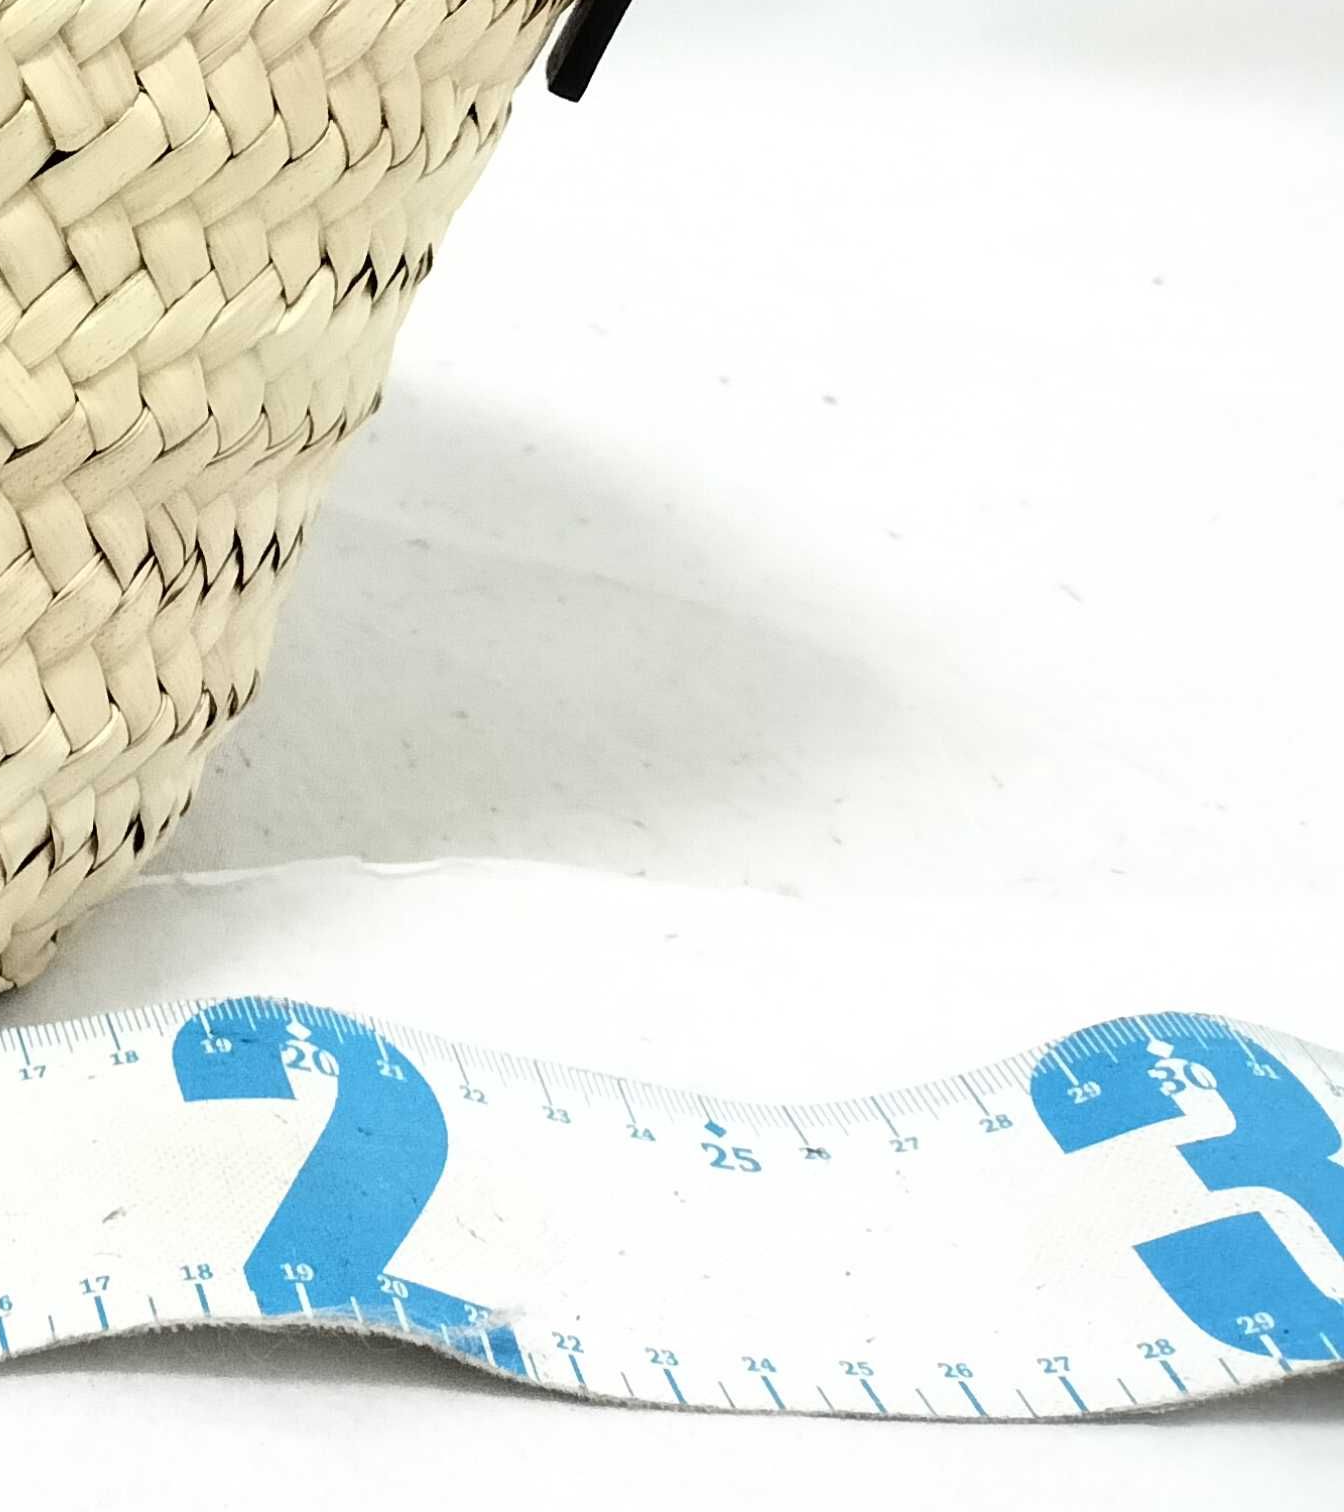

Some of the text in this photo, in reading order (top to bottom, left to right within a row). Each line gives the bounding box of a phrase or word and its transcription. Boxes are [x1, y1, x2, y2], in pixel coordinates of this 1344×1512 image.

[18, 1065, 47, 1081] 17
[110, 1050, 139, 1066] 18
[200, 1038, 234, 1055] 19
[278, 1039, 340, 1077] 20
[460, 1085, 488, 1105] 22
[543, 1105, 572, 1124] 23
[627, 1124, 656, 1143] 24
[701, 1143, 762, 1173] 25
[889, 1137, 920, 1154] 27
[979, 1114, 1013, 1134] 28
[1067, 1081, 1102, 1105] 29
[1146, 1057, 1217, 1096] 30
[172, 996, 528, 1378] 2
[1030, 1011, 1344, 1362] 3
[79, 1276, 111, 1295] 17
[180, 1263, 214, 1281] 18
[279, 1263, 315, 1283] 19
[376, 1274, 409, 1299] 20
[552, 1332, 585, 1354] 22
[645, 1347, 680, 1367] 23
[741, 1356, 777, 1375] 24
[838, 1360, 875, 1378] 25
[938, 1362, 974, 1380] 26
[1036, 1357, 1072, 1374] 27
[1136, 1339, 1177, 1360] 28
[1236, 1312, 1276, 1336] 29
